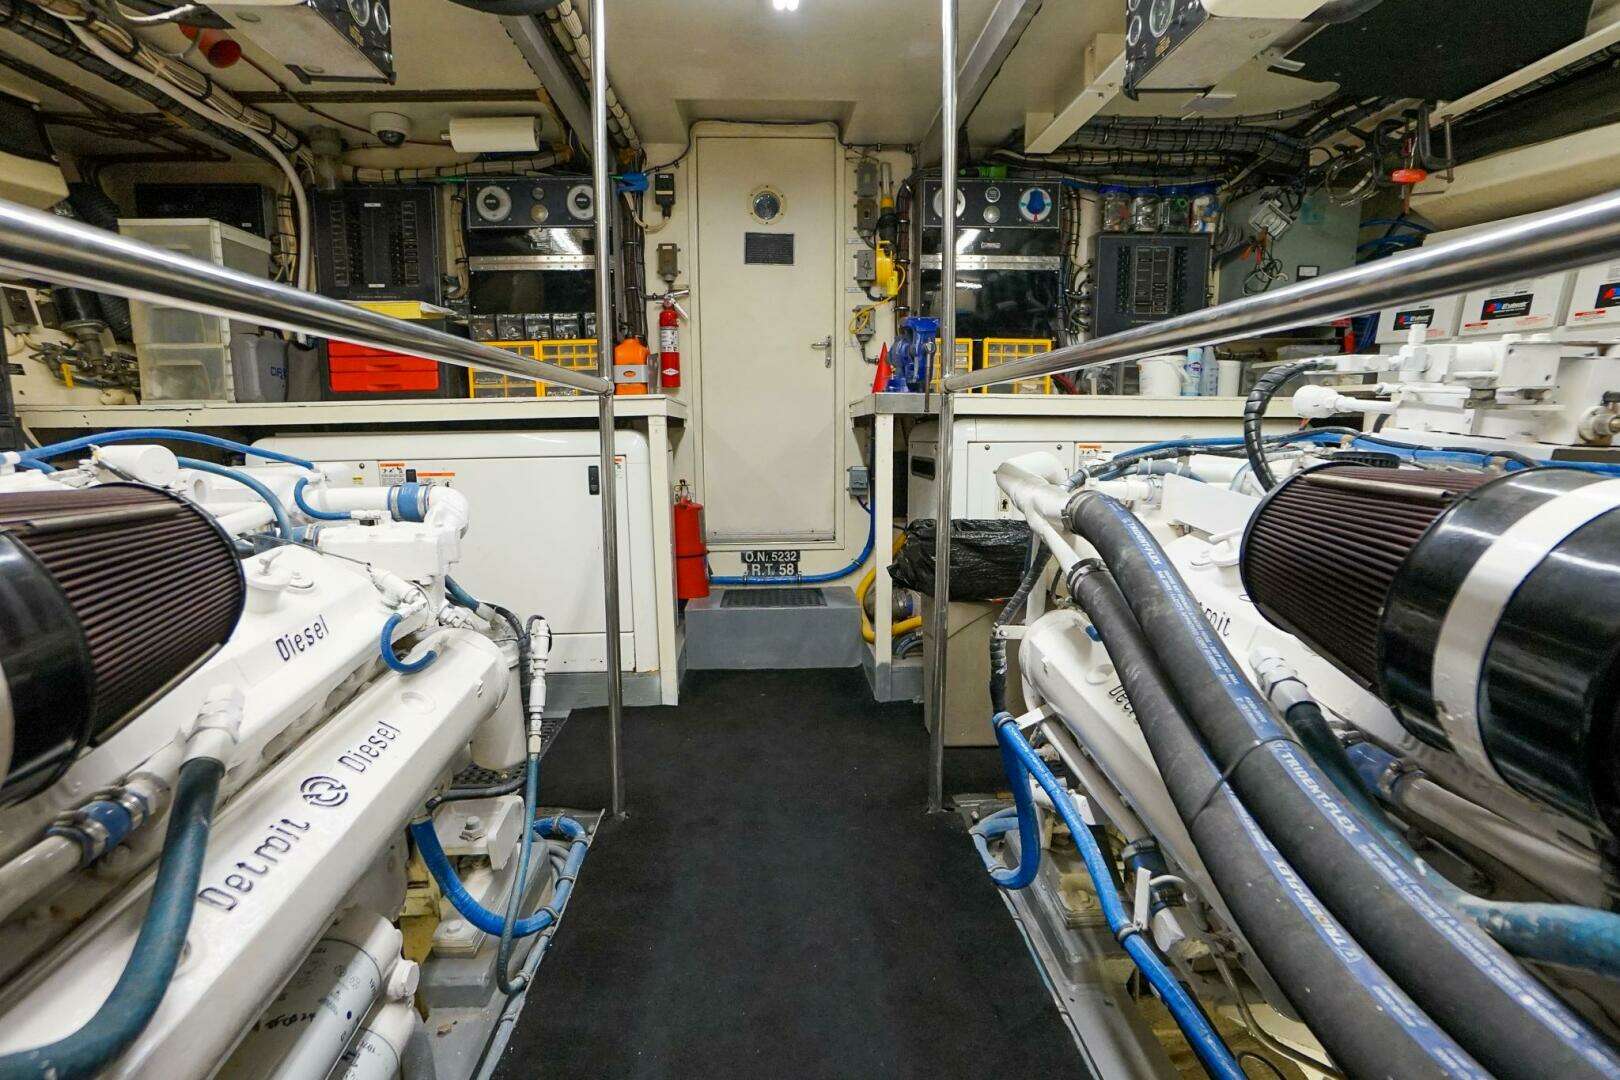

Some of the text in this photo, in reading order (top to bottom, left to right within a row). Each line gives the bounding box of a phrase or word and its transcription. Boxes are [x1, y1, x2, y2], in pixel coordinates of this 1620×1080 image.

[752, 563, 795, 576] R.T. 58
[771, 551, 797, 562] 5232
[275, 614, 329, 662] Diesel
[198, 721, 400, 911] Detroit Diesel
[1281, 751, 1361, 835] TRIDENT-FLEX
